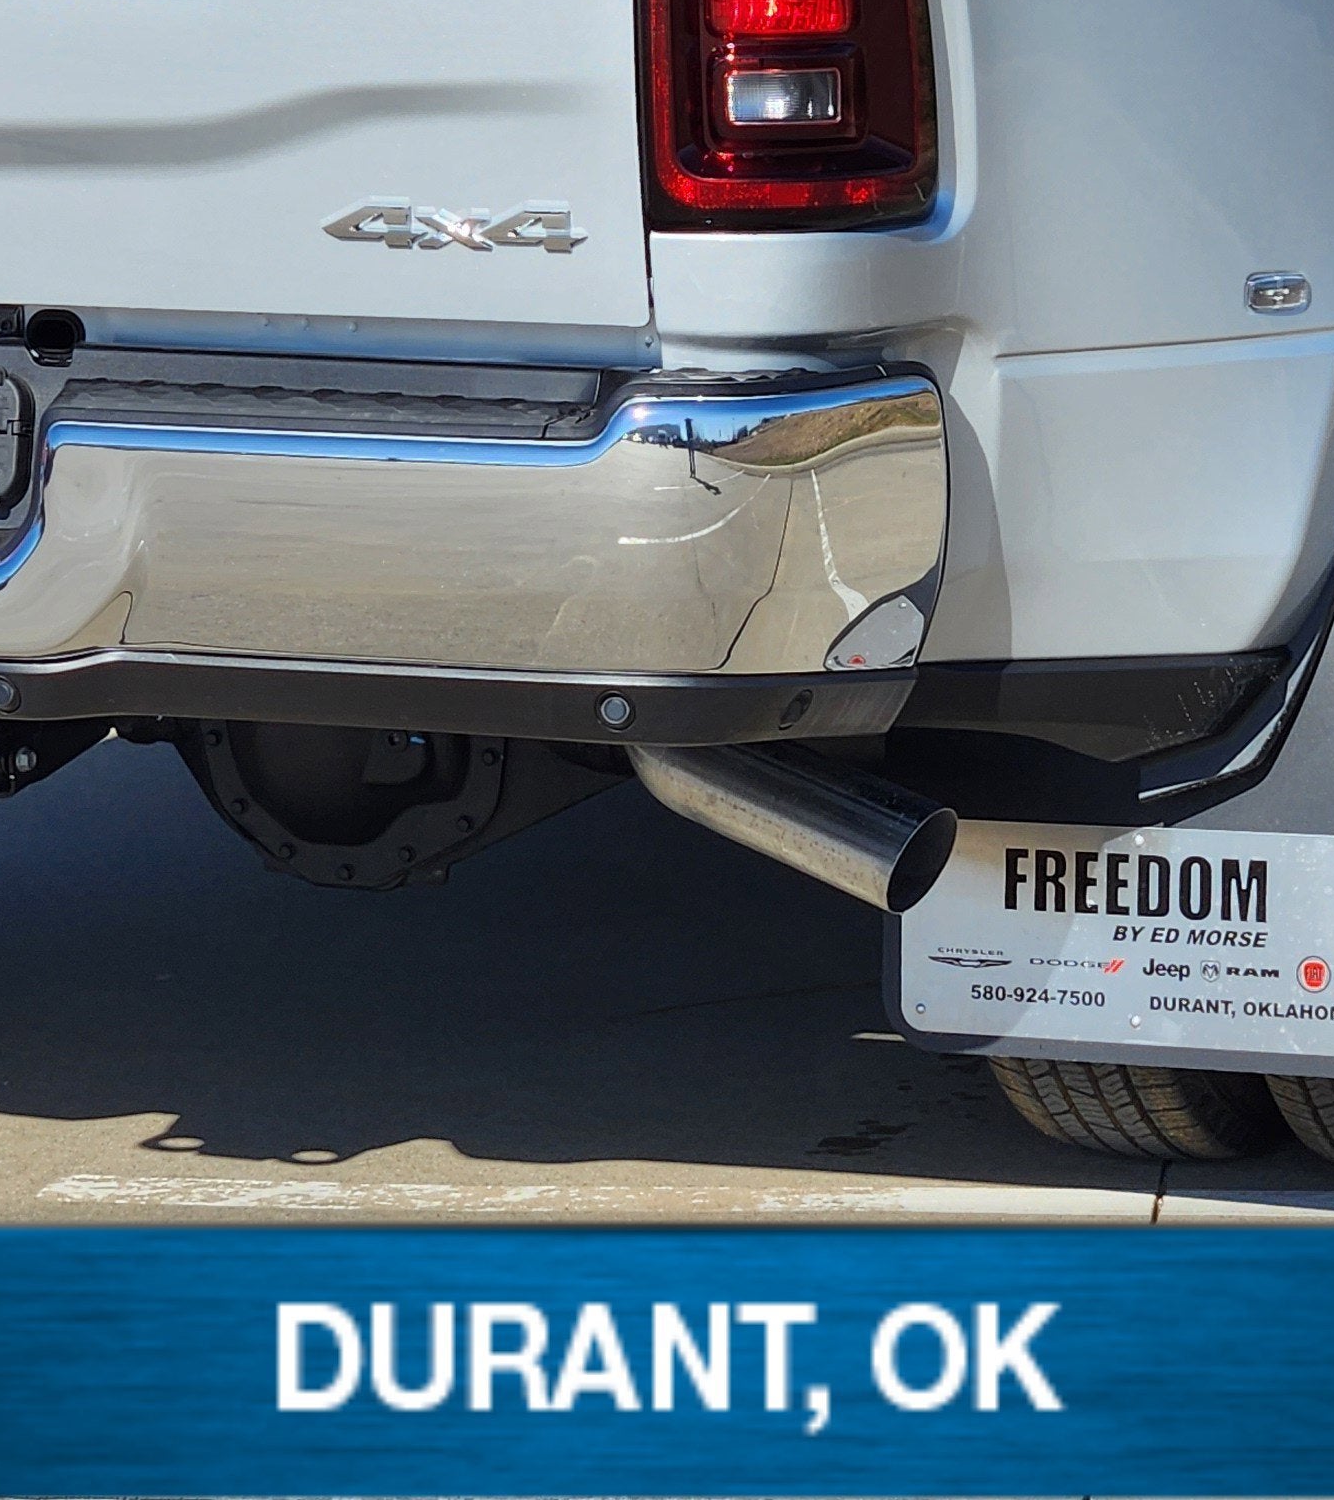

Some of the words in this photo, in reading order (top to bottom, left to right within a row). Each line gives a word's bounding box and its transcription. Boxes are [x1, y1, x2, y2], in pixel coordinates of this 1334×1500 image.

[321, 195, 588, 254] 4x4
[1004, 848, 1268, 923] FREEDOM
[1113, 926, 1145, 942] BY
[1150, 928, 1180, 944] ED
[1186, 929, 1268, 948] MORSE
[937, 947, 1004, 956] CHRYSLER
[1142, 958, 1191, 980] Jeep
[1226, 967, 1280, 978] RAM
[971, 984, 1105, 1007] 580-924-7500
[1150, 996, 1236, 1019] DURANT,
